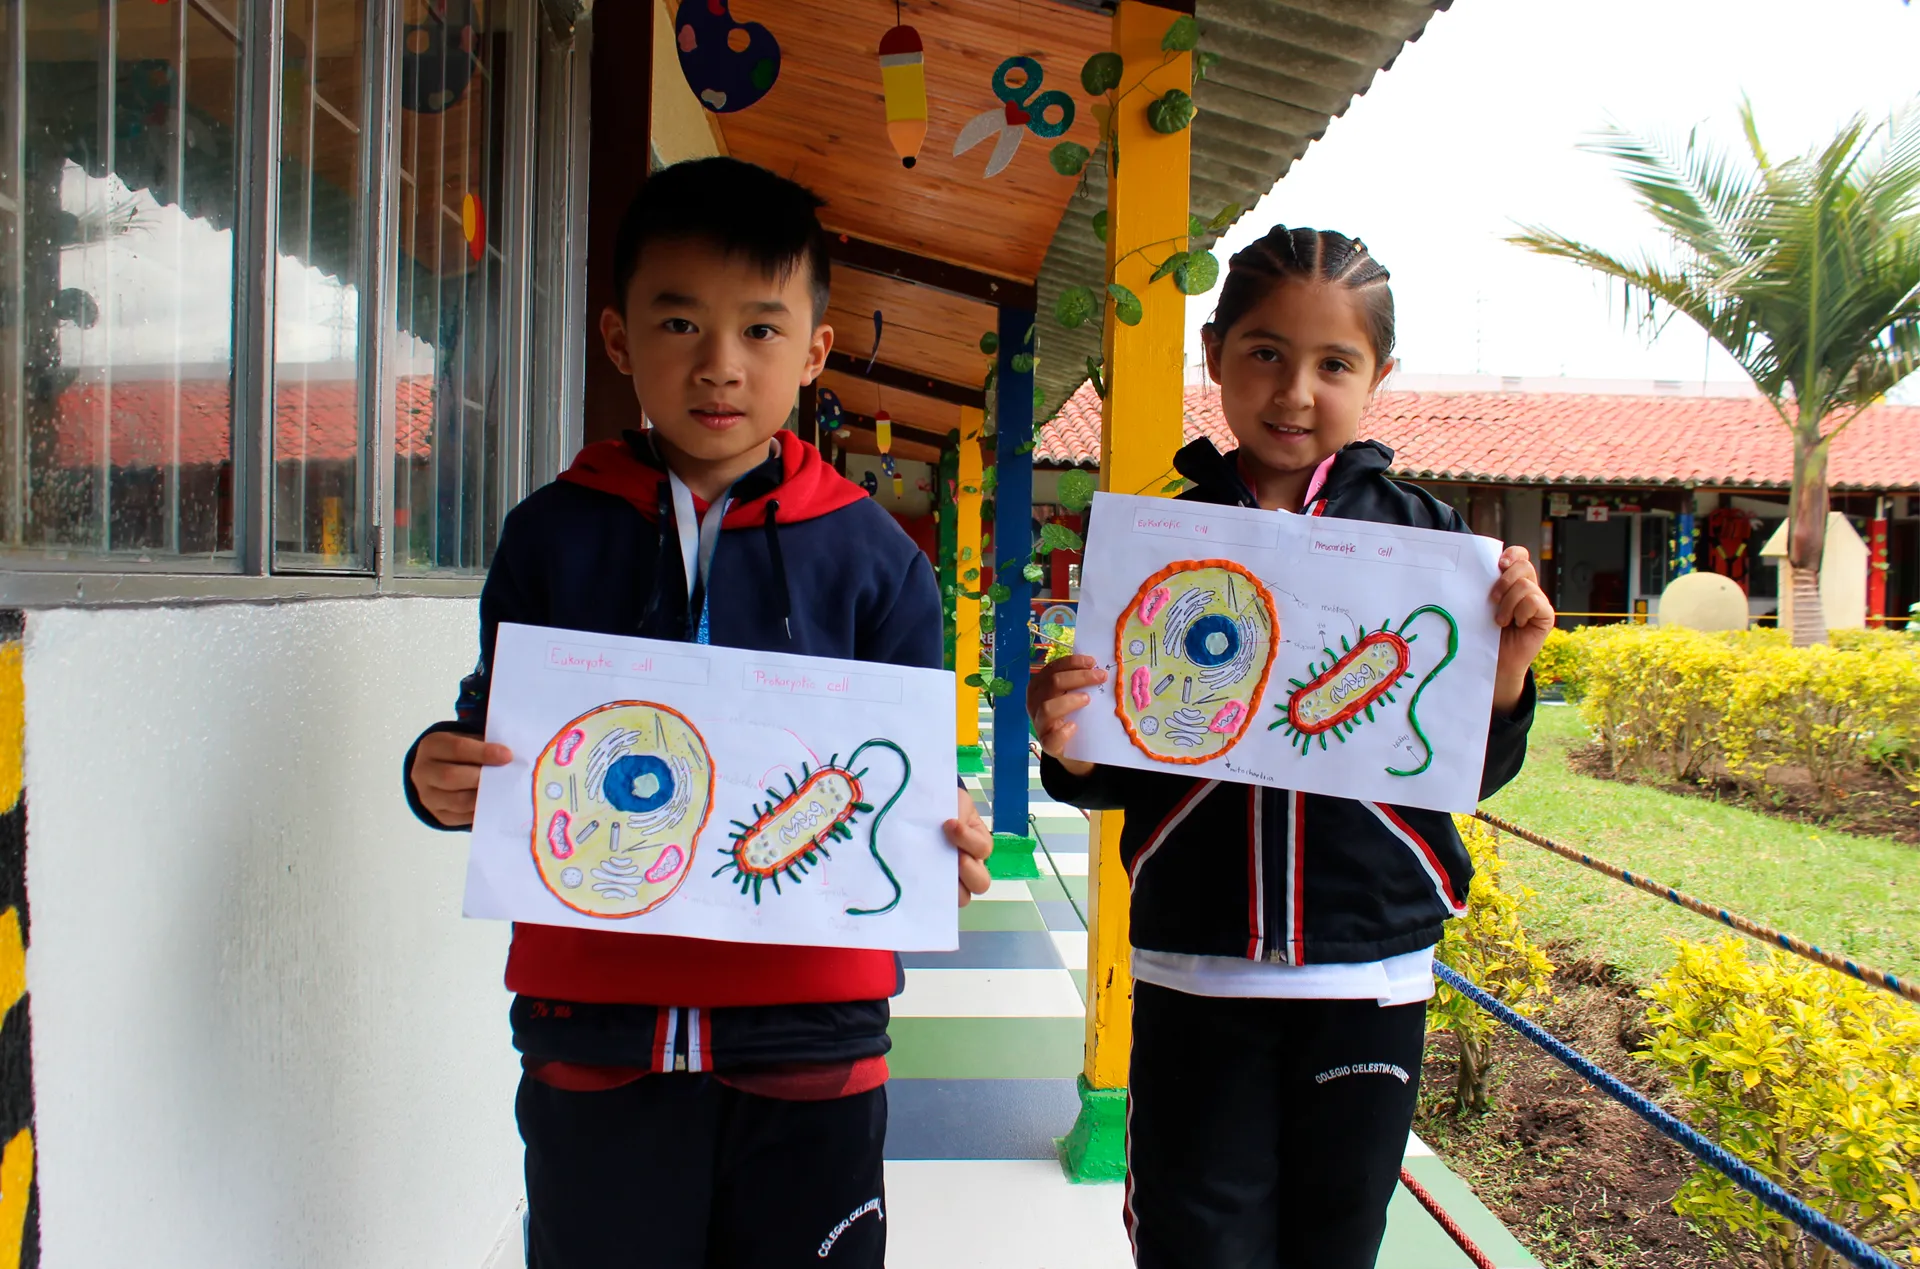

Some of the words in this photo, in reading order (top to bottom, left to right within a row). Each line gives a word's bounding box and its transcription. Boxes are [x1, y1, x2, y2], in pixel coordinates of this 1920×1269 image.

[551, 647, 613, 672] Eukaryotic
[631, 658, 653, 672] cell
[754, 670, 815, 692] Prokaryotic
[826, 677, 849, 693] cell
[1315, 1065, 1351, 1084] COLEGIO
[818, 1219, 850, 1257] COLEGIO
